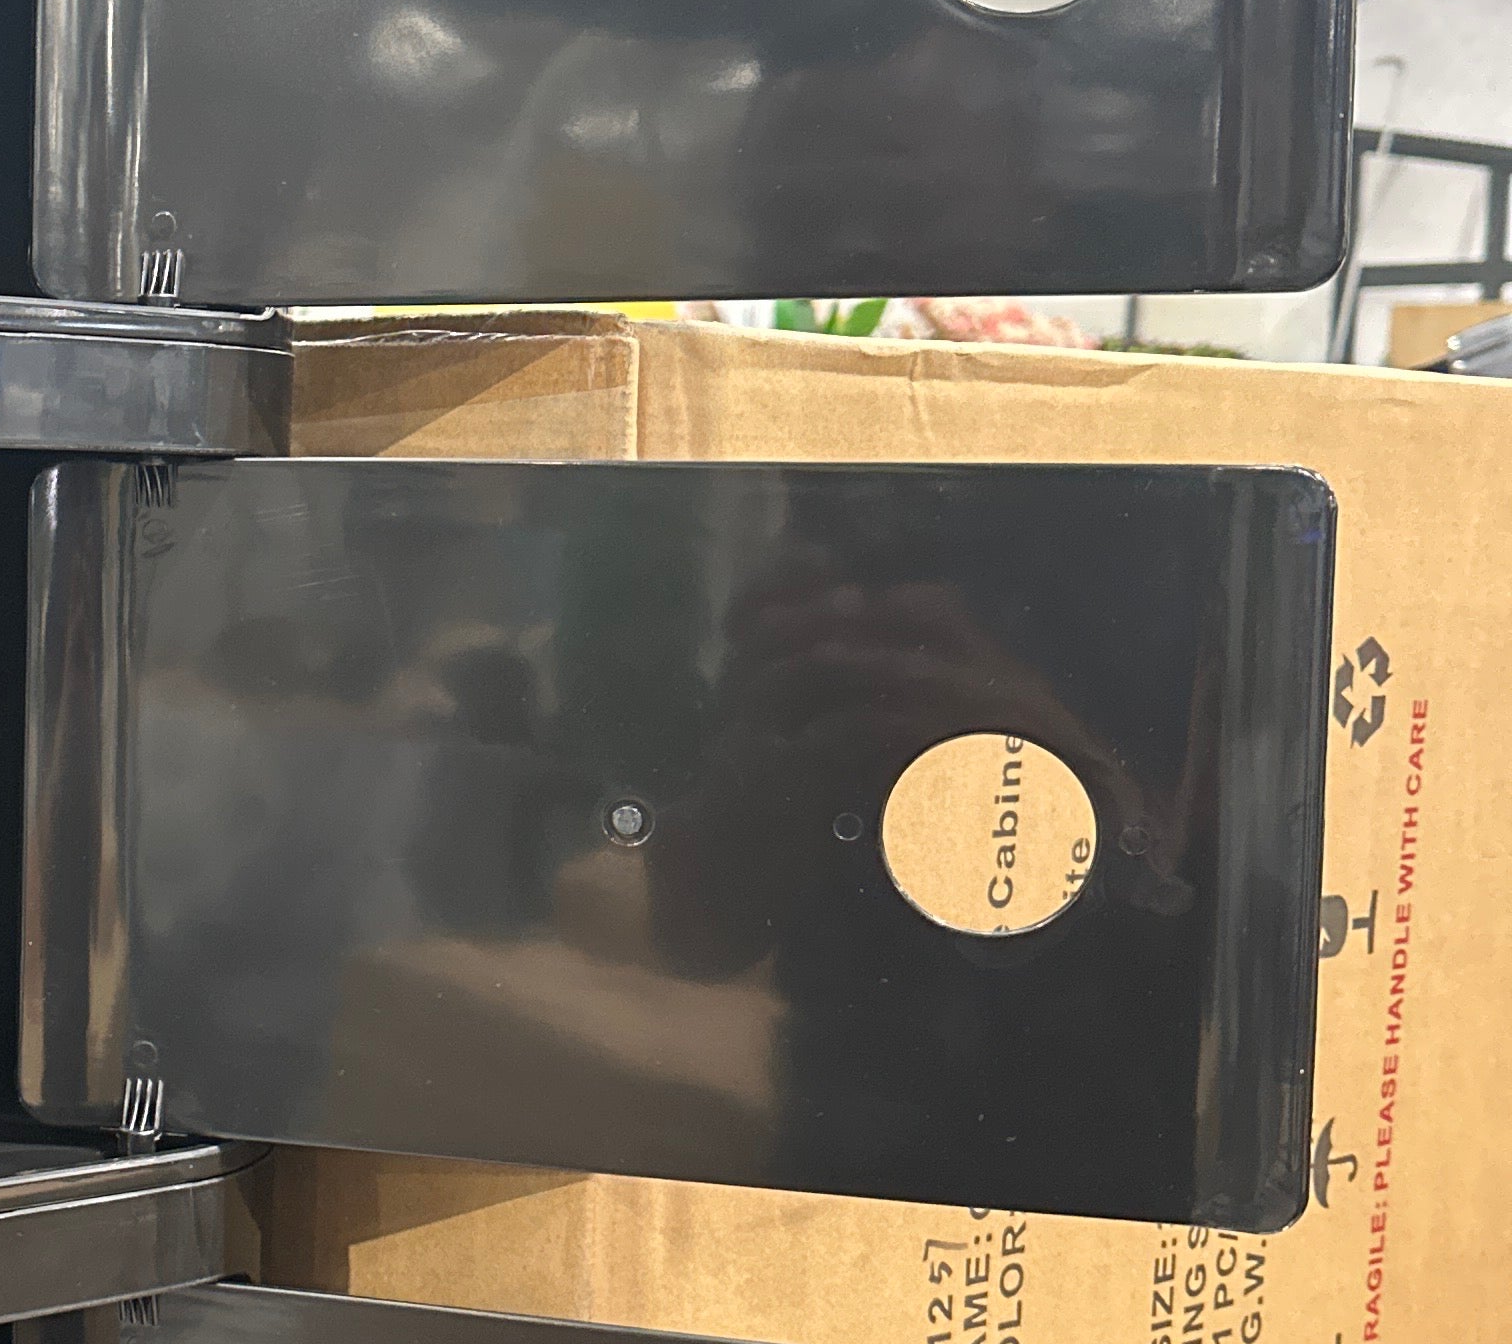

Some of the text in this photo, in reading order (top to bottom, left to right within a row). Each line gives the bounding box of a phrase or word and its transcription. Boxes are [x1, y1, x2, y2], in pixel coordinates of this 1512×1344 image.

[1405, 699, 1428, 796] CARE
[1398, 805, 1420, 895] WITH
[1385, 901, 1412, 1047] HANDLE
[1373, 1053, 1398, 1192] PLEASE
